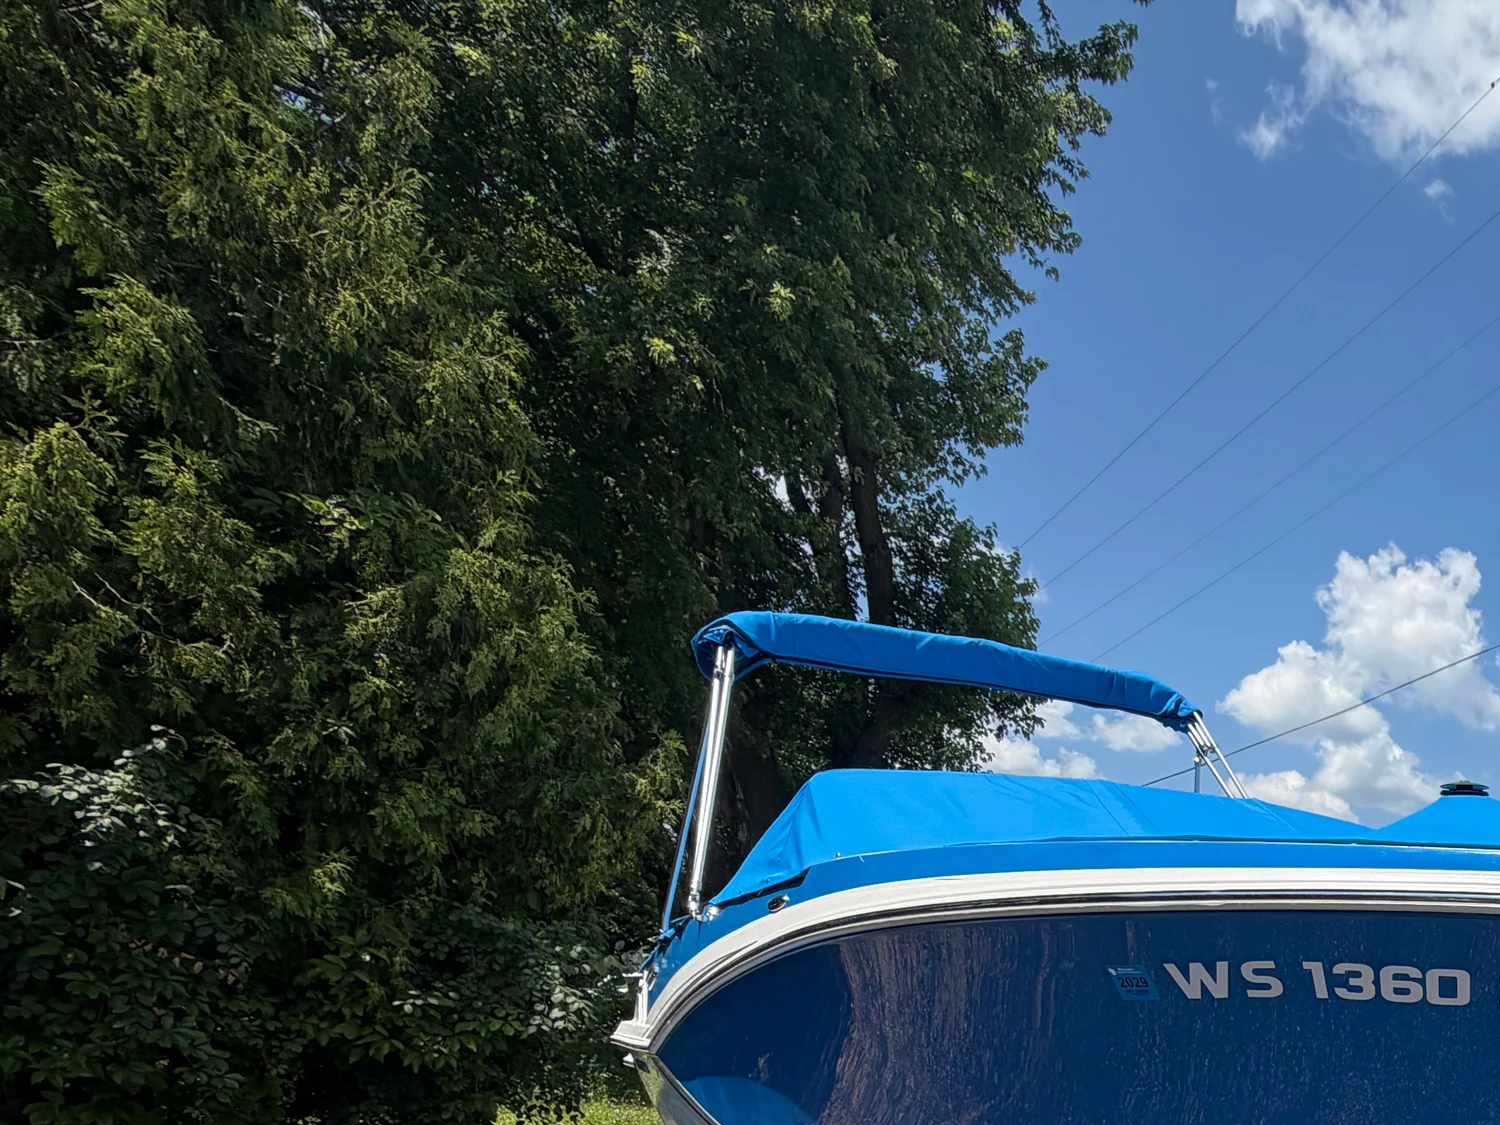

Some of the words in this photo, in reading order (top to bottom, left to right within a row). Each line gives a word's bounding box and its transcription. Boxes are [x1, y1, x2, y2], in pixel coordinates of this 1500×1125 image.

[1117, 976, 1149, 988] 2029
[1162, 960, 1284, 1000] WS
[1302, 961, 1471, 1006] 1360
